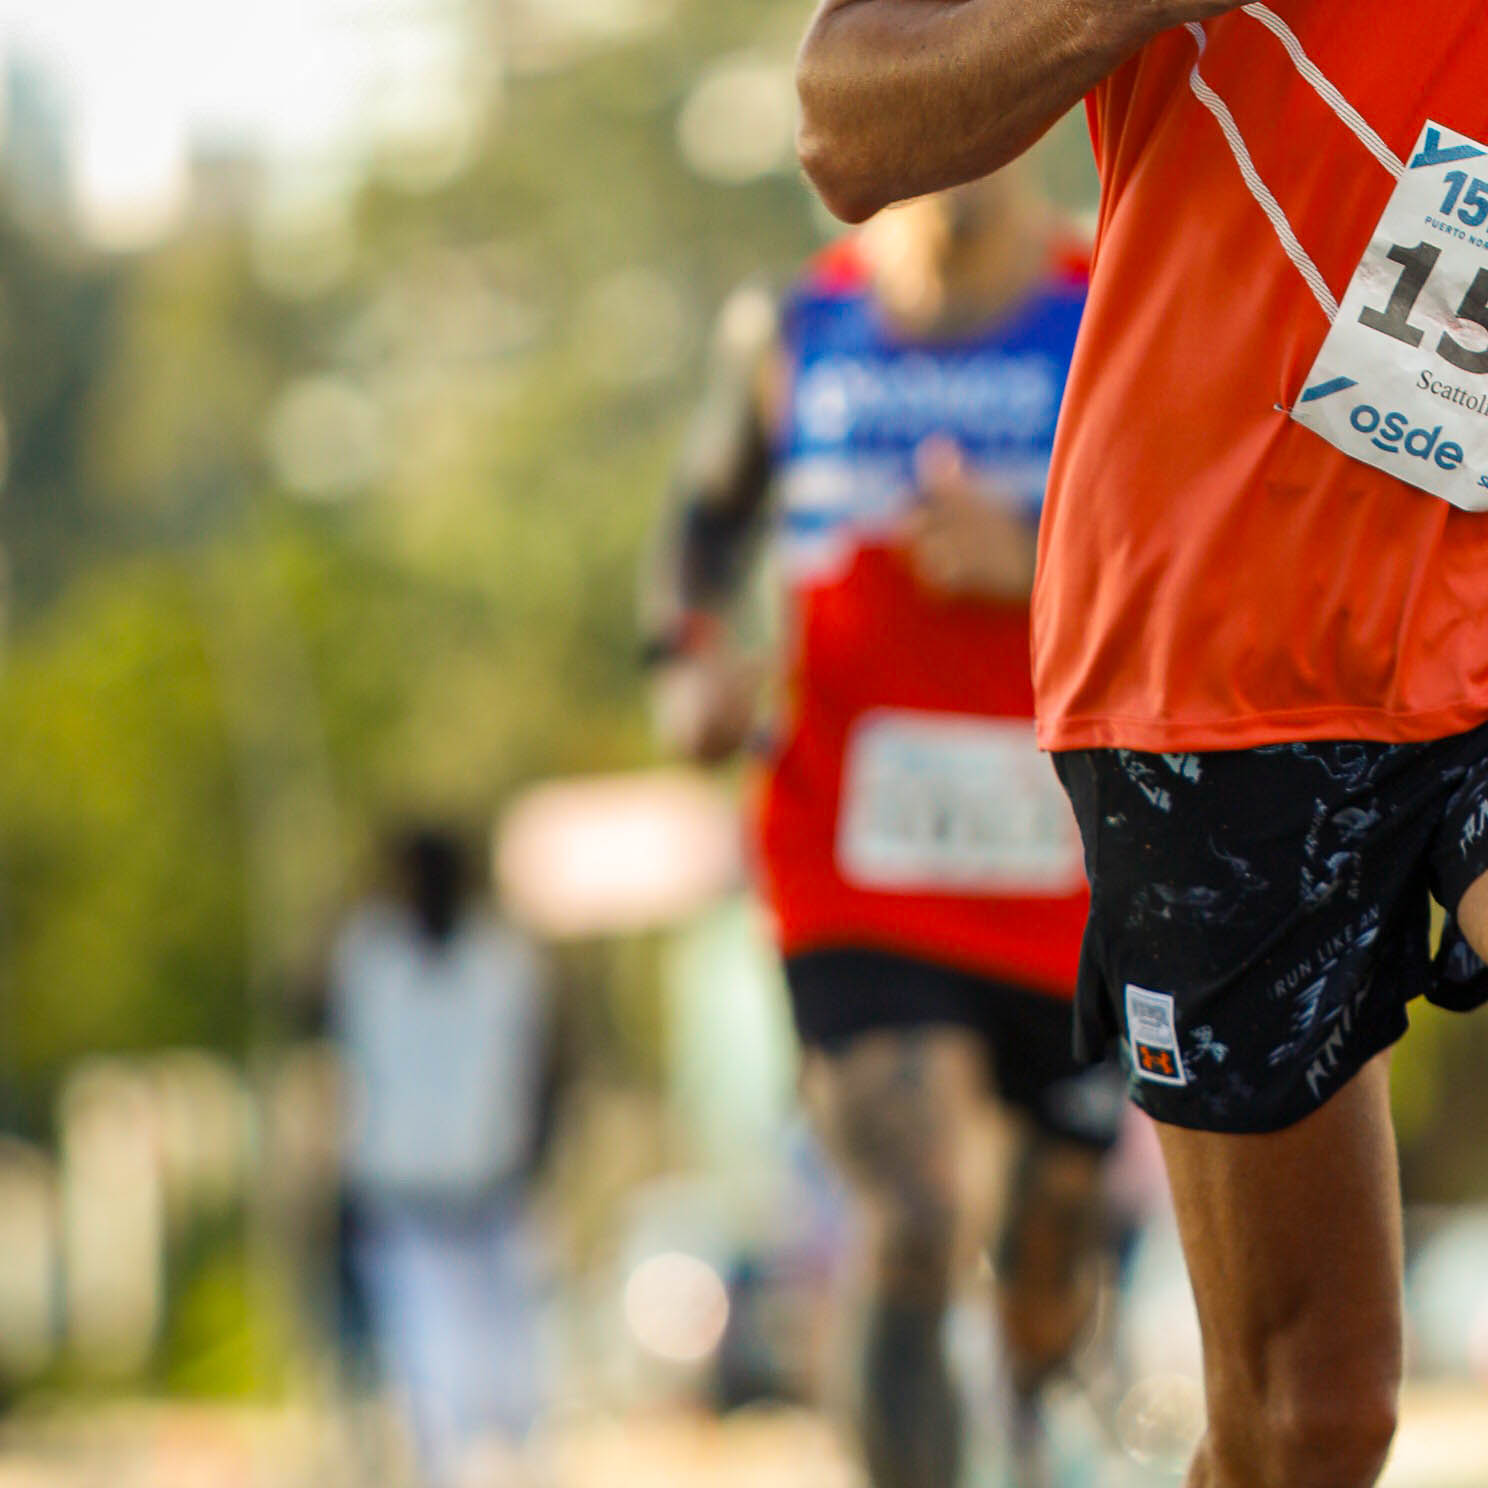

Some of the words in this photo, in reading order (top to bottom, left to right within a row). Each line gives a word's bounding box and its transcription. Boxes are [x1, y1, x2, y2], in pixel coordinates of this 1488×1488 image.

[1424, 216, 1466, 241] PUERTO
[1350, 404, 1464, 470] osde
[1274, 961, 1312, 998] RUN
[1316, 924, 1353, 963] LIKE
